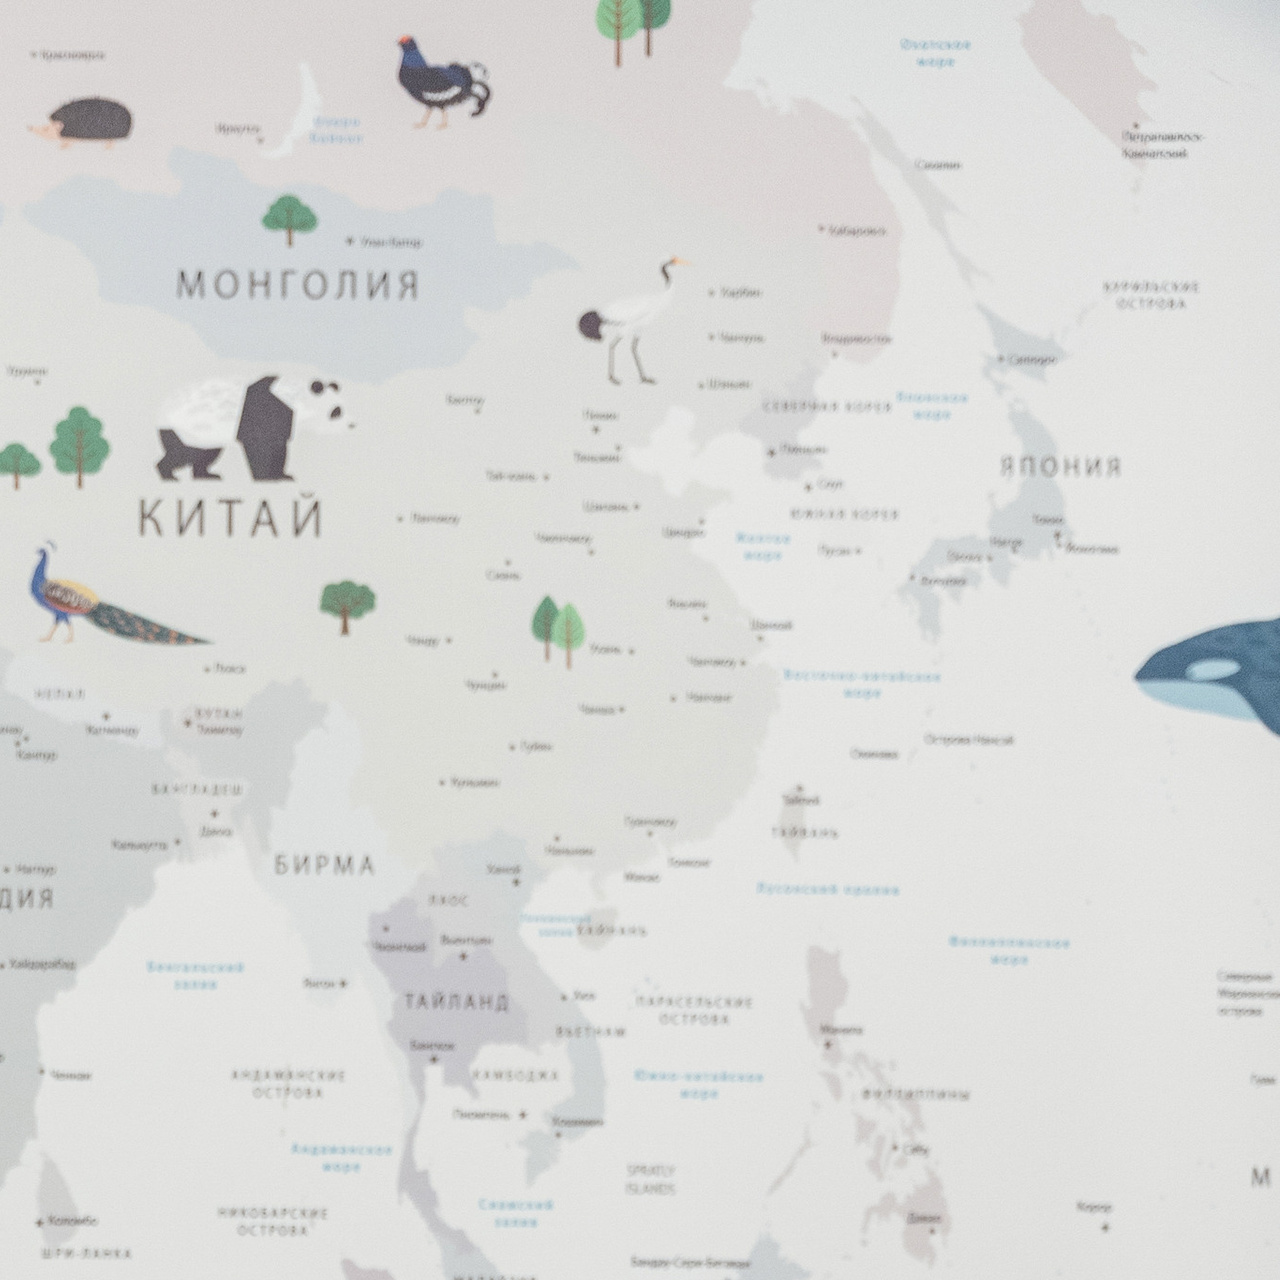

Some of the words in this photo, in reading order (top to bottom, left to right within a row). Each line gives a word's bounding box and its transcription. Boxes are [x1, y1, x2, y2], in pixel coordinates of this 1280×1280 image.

[176, 269, 418, 300] МОНГОЛИЯ
[1000, 455, 1121, 477] ЯПОНИЯ
[139, 494, 321, 537] КИТАЙ
[274, 854, 374, 875] БИРМА
[404, 991, 509, 1012] ТАЙЛАНД
